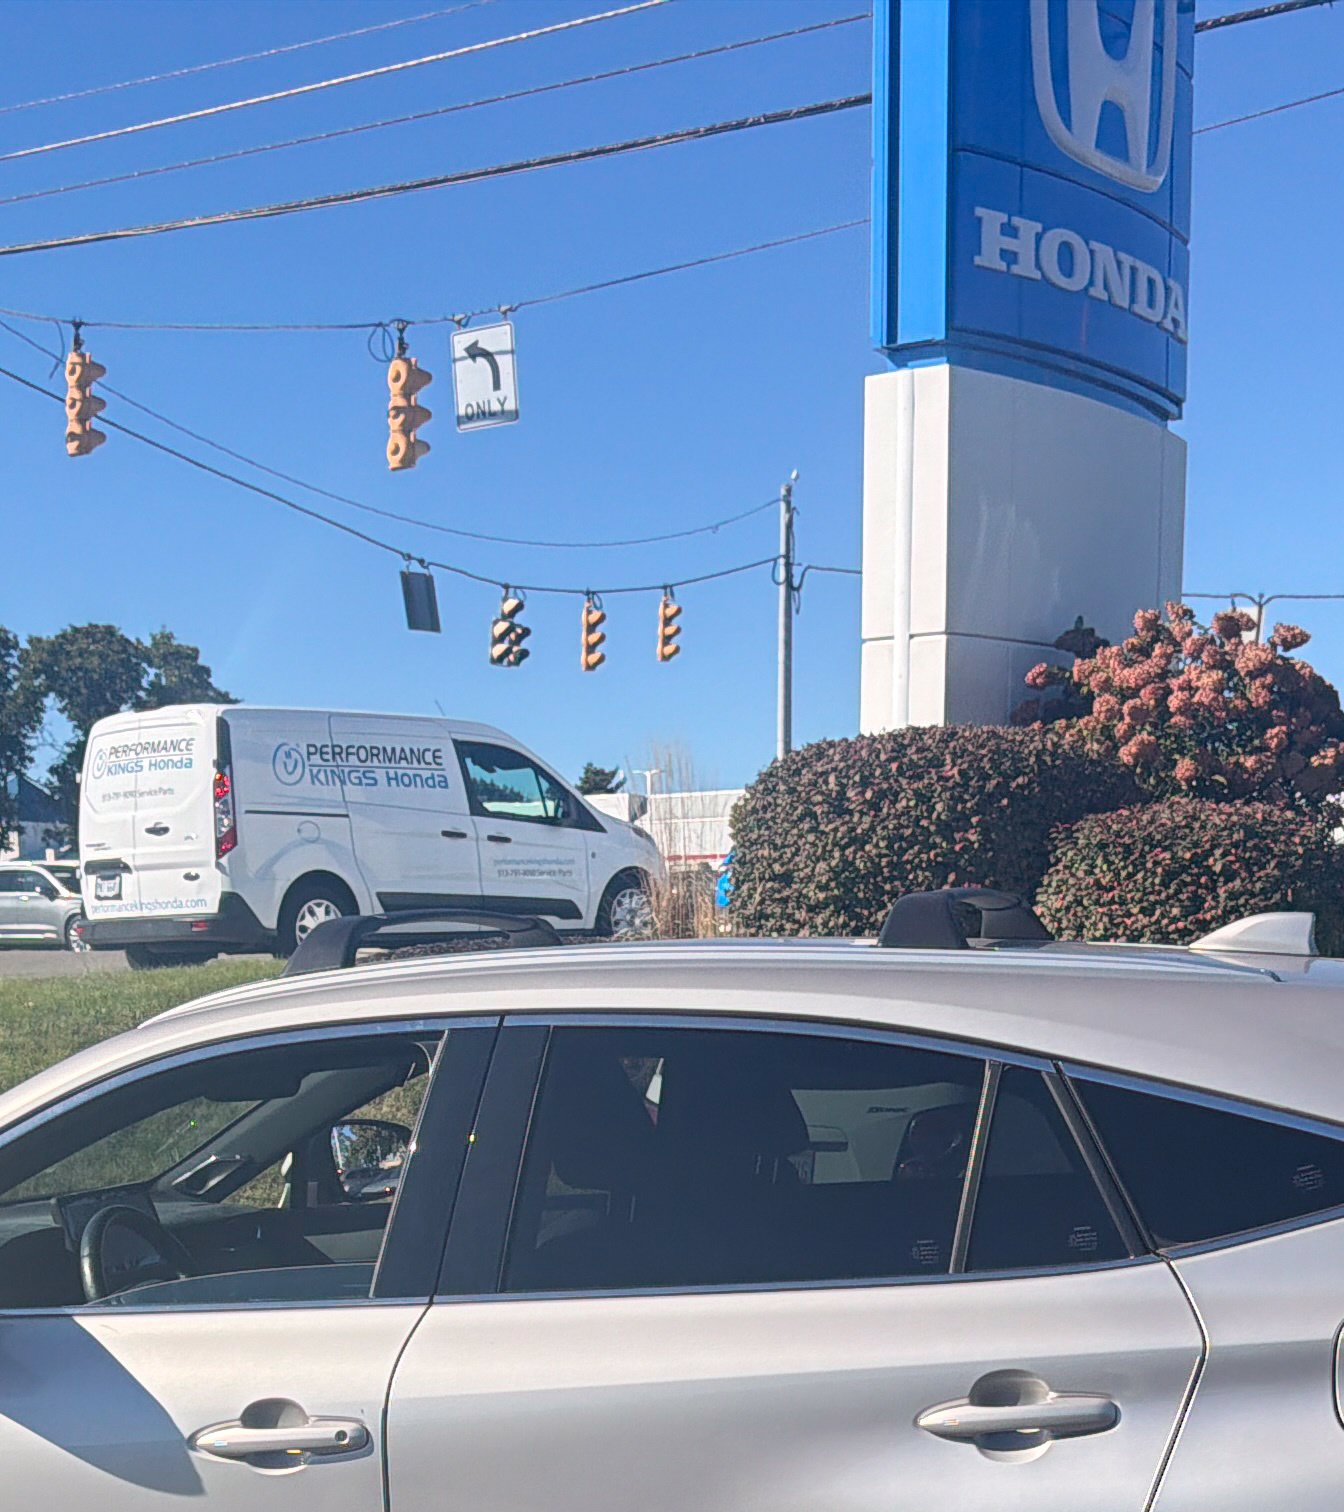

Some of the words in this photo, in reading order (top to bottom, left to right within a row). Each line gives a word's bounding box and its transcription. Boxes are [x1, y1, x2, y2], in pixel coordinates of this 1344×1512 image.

[974, 207, 1188, 344] HONDA
[464, 396, 508, 420] ONLY
[108, 738, 195, 760] PERFORMANCE
[306, 743, 444, 767] PERFORMANCE
[106, 760, 144, 776] KINGS
[149, 757, 193, 771] Honda
[309, 767, 378, 787] KINGS
[385, 770, 449, 789] Honda
